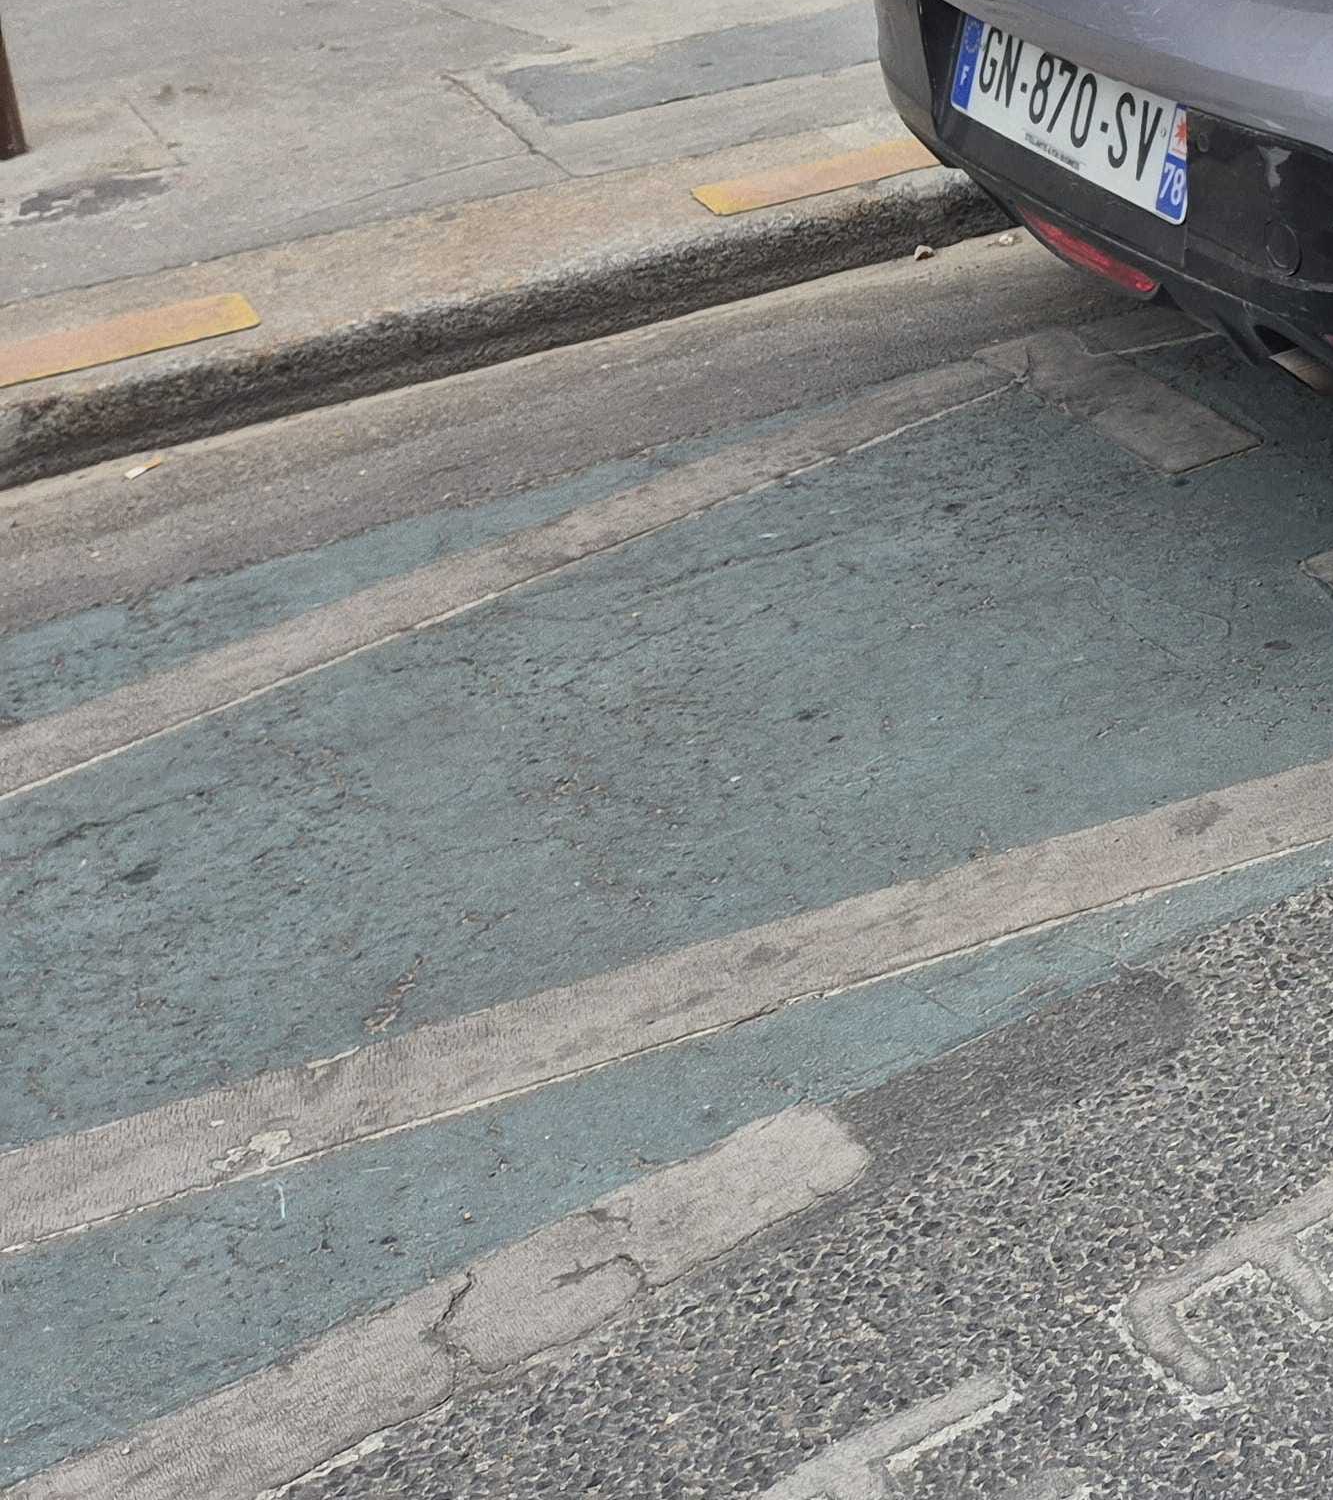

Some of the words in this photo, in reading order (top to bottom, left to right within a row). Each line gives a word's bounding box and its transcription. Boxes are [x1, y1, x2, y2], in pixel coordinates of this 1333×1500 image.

[959, 65, 971, 86] F
[979, 26, 1164, 182] GN-870-SV
[1158, 161, 1186, 206] 78
